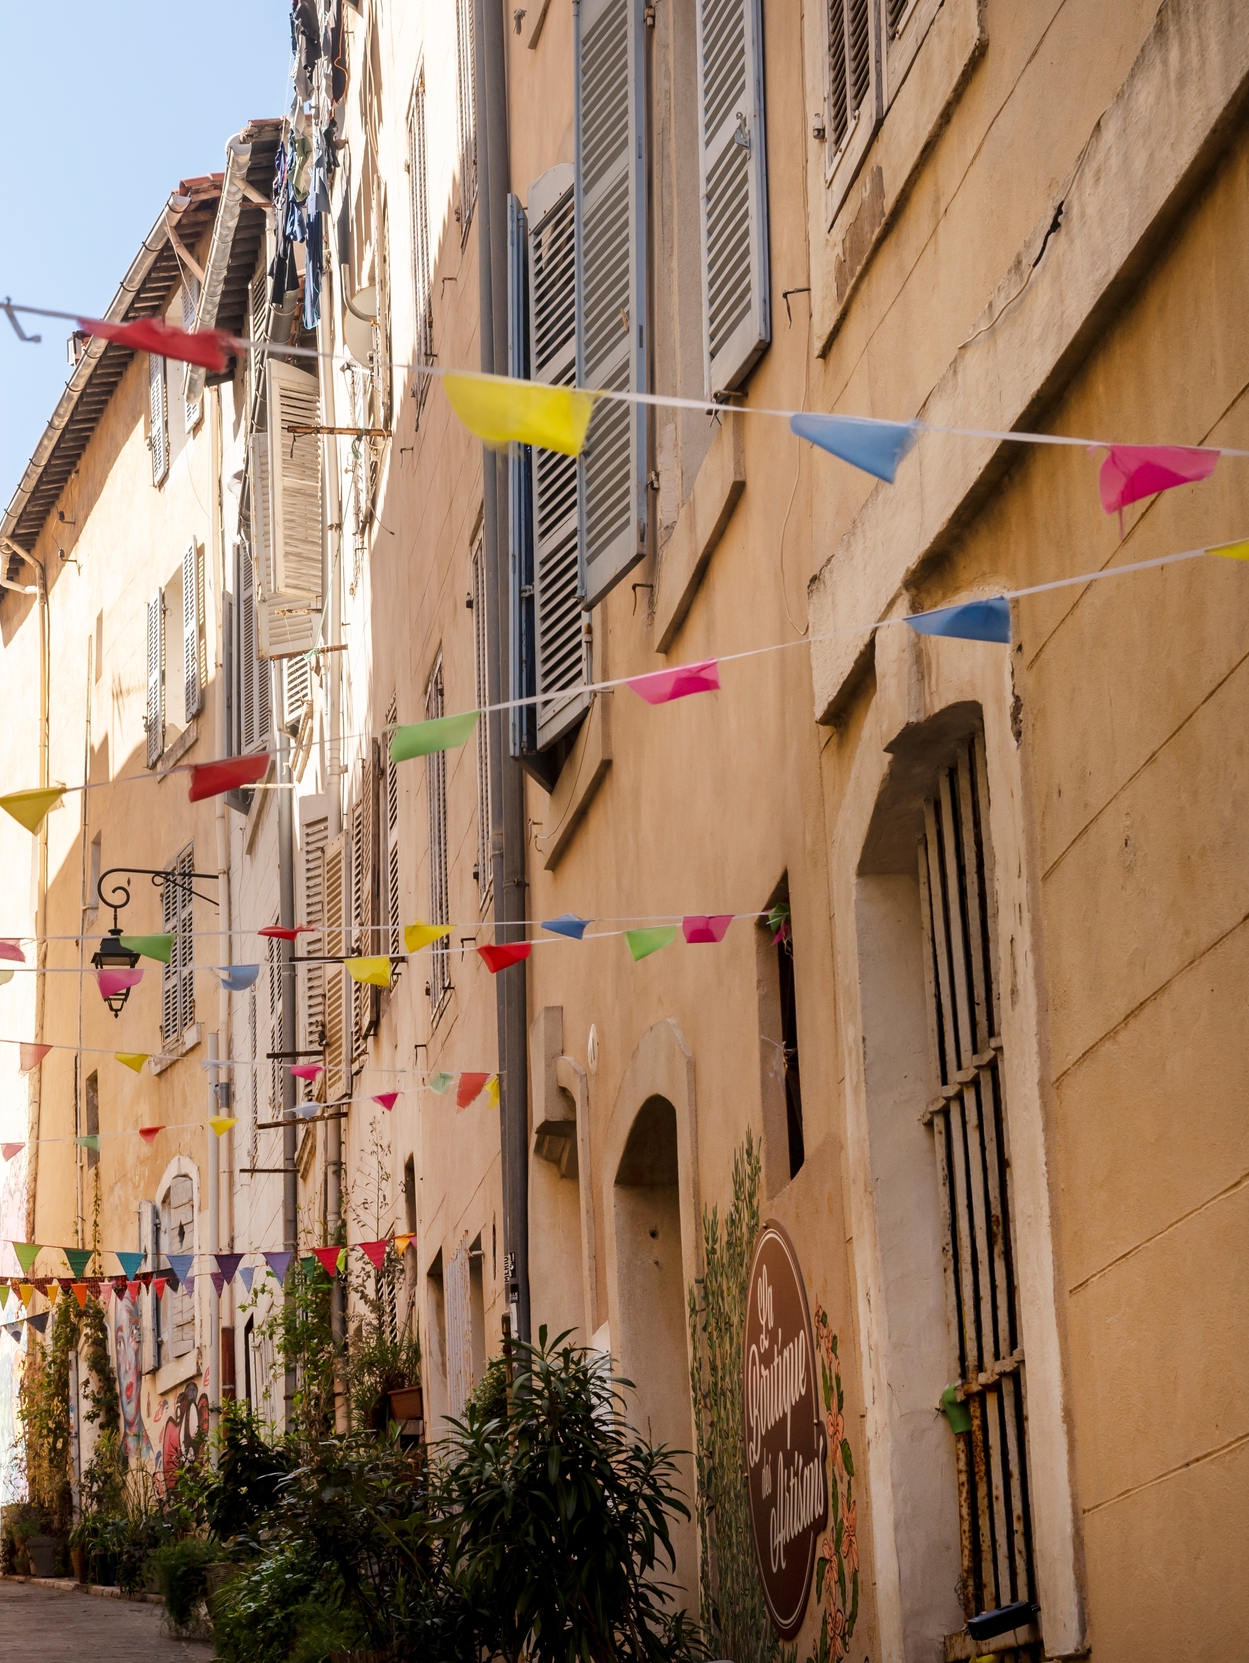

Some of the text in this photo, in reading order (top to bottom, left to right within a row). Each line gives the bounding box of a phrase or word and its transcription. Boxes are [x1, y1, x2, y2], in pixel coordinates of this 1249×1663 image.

[757, 1264, 774, 1353] La
[748, 1328, 807, 1468] Boutique
[762, 1448, 772, 1499] des
[770, 1435, 824, 1573] Artisans
